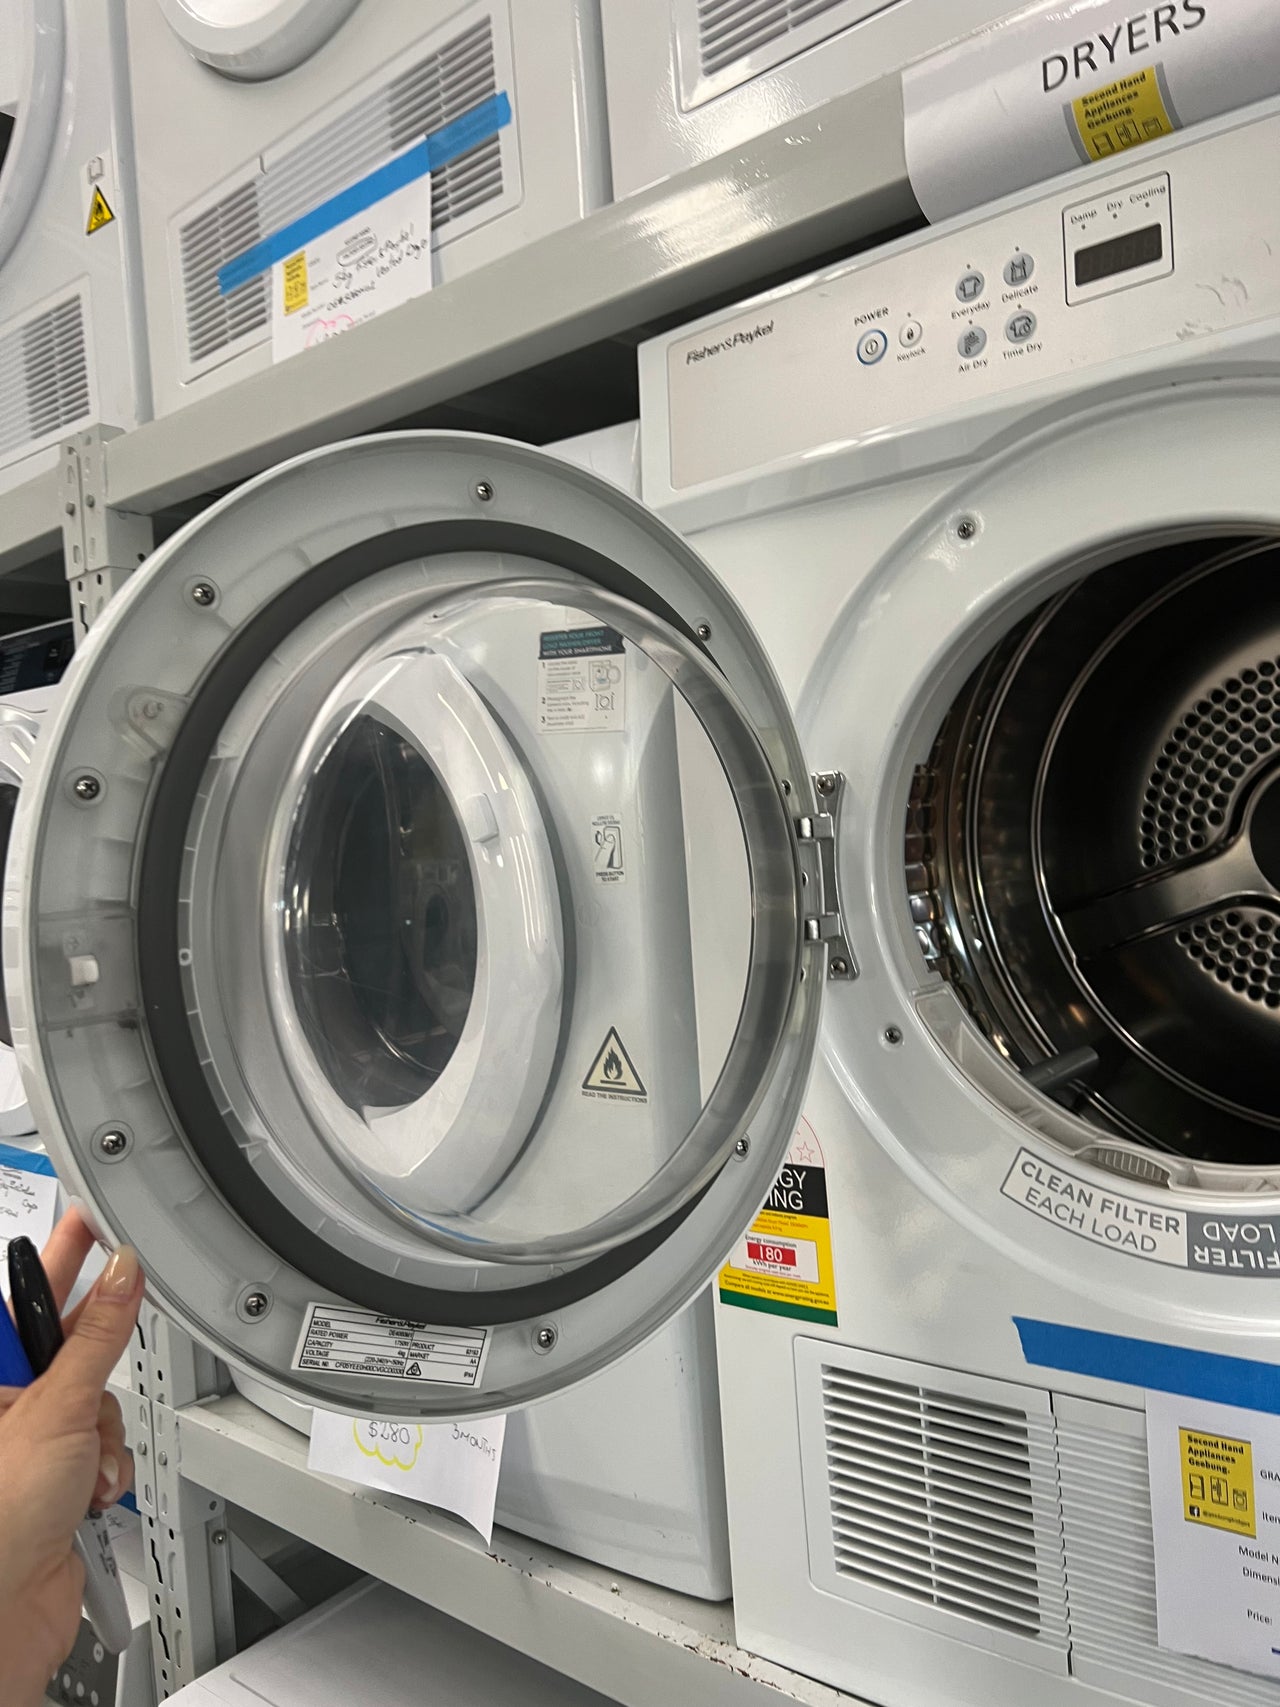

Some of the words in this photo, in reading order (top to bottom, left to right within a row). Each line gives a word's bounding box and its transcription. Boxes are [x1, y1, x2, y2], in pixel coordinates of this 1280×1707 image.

[1042, 0, 1206, 93] DRYERS
[1081, 84, 1119, 107] Second
[1120, 72, 1147, 92] Hand
[1084, 90, 1140, 119] Appliances
[1070, 209, 1098, 225] Damp
[1106, 200, 1124, 212] Dry
[1129, 185, 1167, 204] Cooling
[1001, 284, 1039, 304] Delicate
[853, 306, 890, 327] POWER
[951, 300, 991, 320] Everyday
[896, 346, 927, 363] Keylock
[1002, 346, 1024, 361] Time
[1026, 341, 1044, 355] Dry
[958, 362, 970, 374] Air
[972, 358, 989, 371] Dry
[582, 1090, 596, 1098] READ
[597, 1092, 607, 1100] THE
[608, 1093, 648, 1104] INSTRUCTIONS
[1021, 1160, 1094, 1208] CLEAN
[1100, 1197, 1180, 1235] FILTER
[1025, 1186, 1085, 1230] EACH
[1092, 1217, 1157, 1253] LOAD
[1203, 1221, 1276, 1243] LOAD
[759, 1245, 783, 1263] 180
[1194, 1244, 1280, 1269] FILTER
[768, 1262, 778, 1270] per
[779, 1264, 792, 1272] year
[310, 1328, 328, 1337] RATED
[329, 1331, 349, 1340] POWER
[313, 1320, 331, 1328] MODEL
[305, 1349, 330, 1358] VOLTAGE
[307, 1339, 334, 1349] CAPACITY
[411, 1341, 436, 1351] PRODUCT
[302, 1358, 320, 1367] SERIAL
[410, 1351, 431, 1360] MARKET
[368, 1421, 411, 1445] $280
[1187, 1434, 1220, 1450] Second
[1221, 1440, 1244, 1455] Hand
[1188, 1445, 1237, 1465] Appliances
[1238, 1545, 1269, 1563] Model
[1247, 1608, 1273, 1626] Price:
